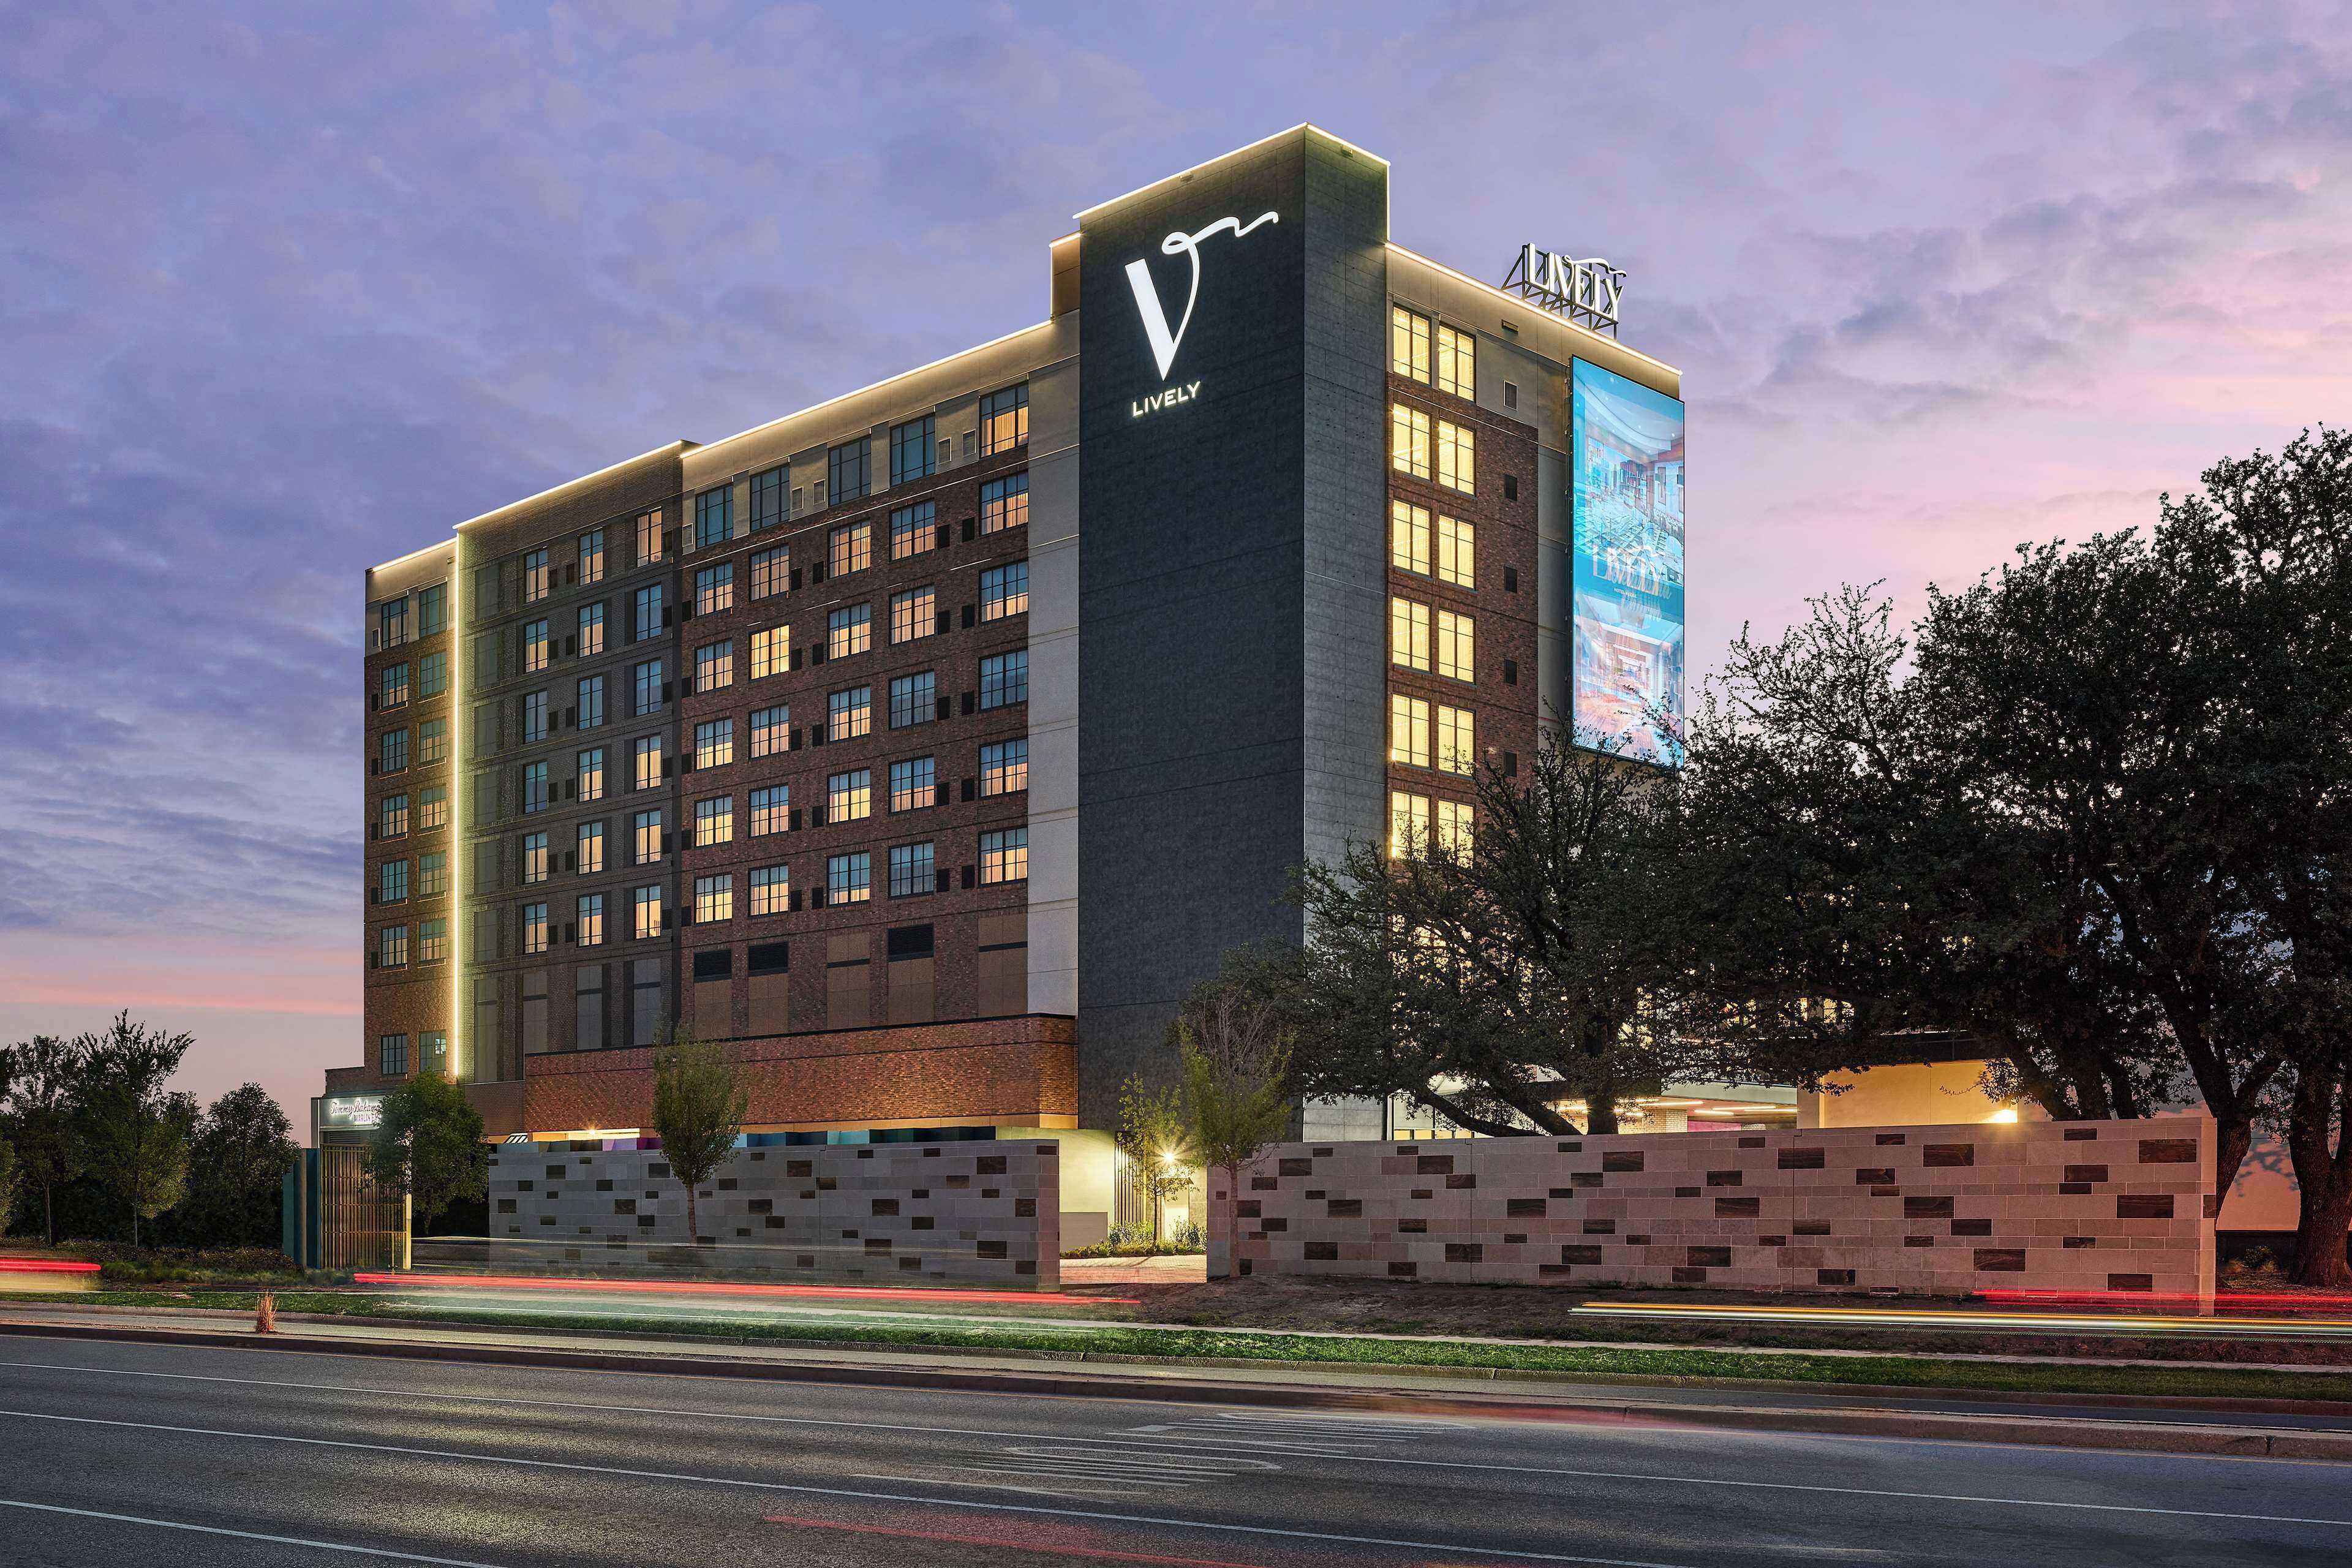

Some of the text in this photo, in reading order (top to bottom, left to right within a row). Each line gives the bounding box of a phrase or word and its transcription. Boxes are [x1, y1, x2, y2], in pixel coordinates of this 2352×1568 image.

[1528, 242, 1627, 323] LIVELY
[1132, 381, 1201, 418] LIVELY
[331, 1101, 353, 1118] Tommy
[353, 1114, 371, 1122] MARLIN
